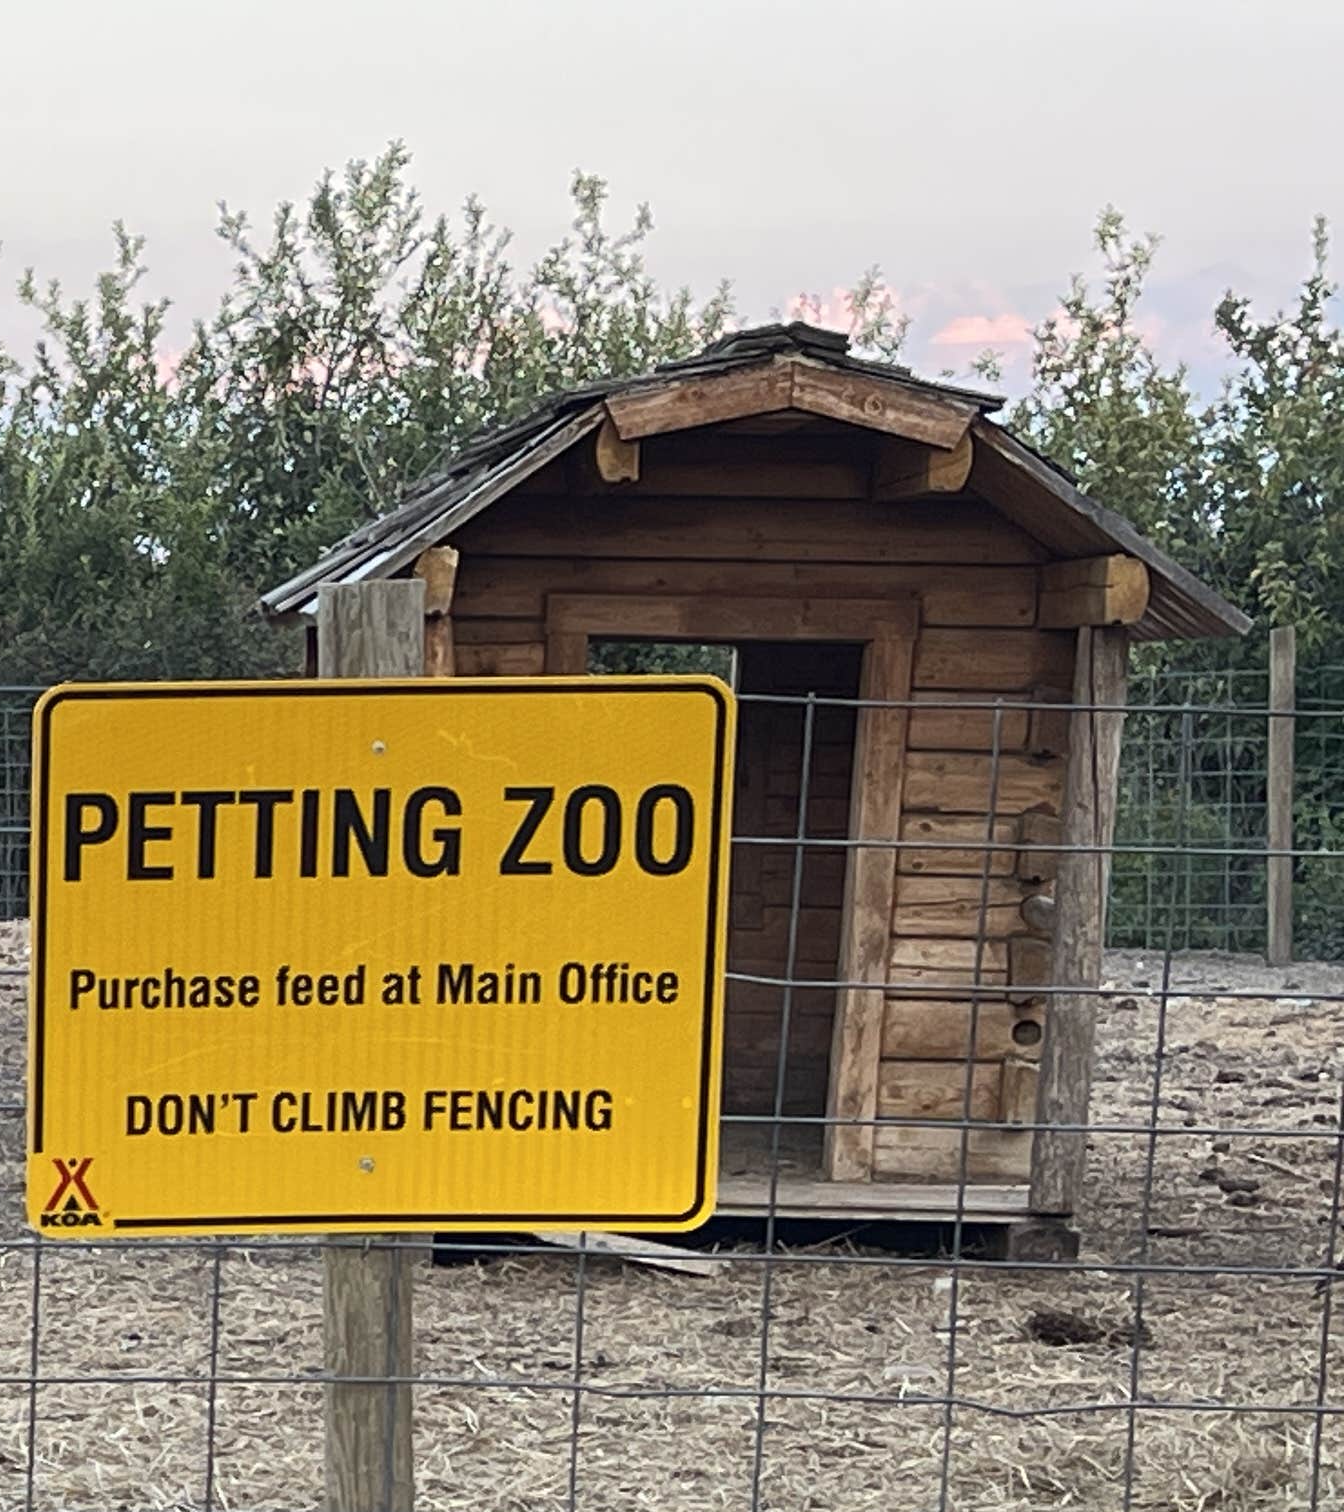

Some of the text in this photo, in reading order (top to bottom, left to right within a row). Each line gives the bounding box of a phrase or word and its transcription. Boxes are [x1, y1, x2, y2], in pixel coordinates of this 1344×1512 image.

[63, 783, 695, 883] PETTING ZOO
[70, 962, 679, 1010] Purchase feed at Main Office
[126, 1089, 613, 1136] DON'T CLIMB FENCING
[40, 1212, 102, 1228] KOA
